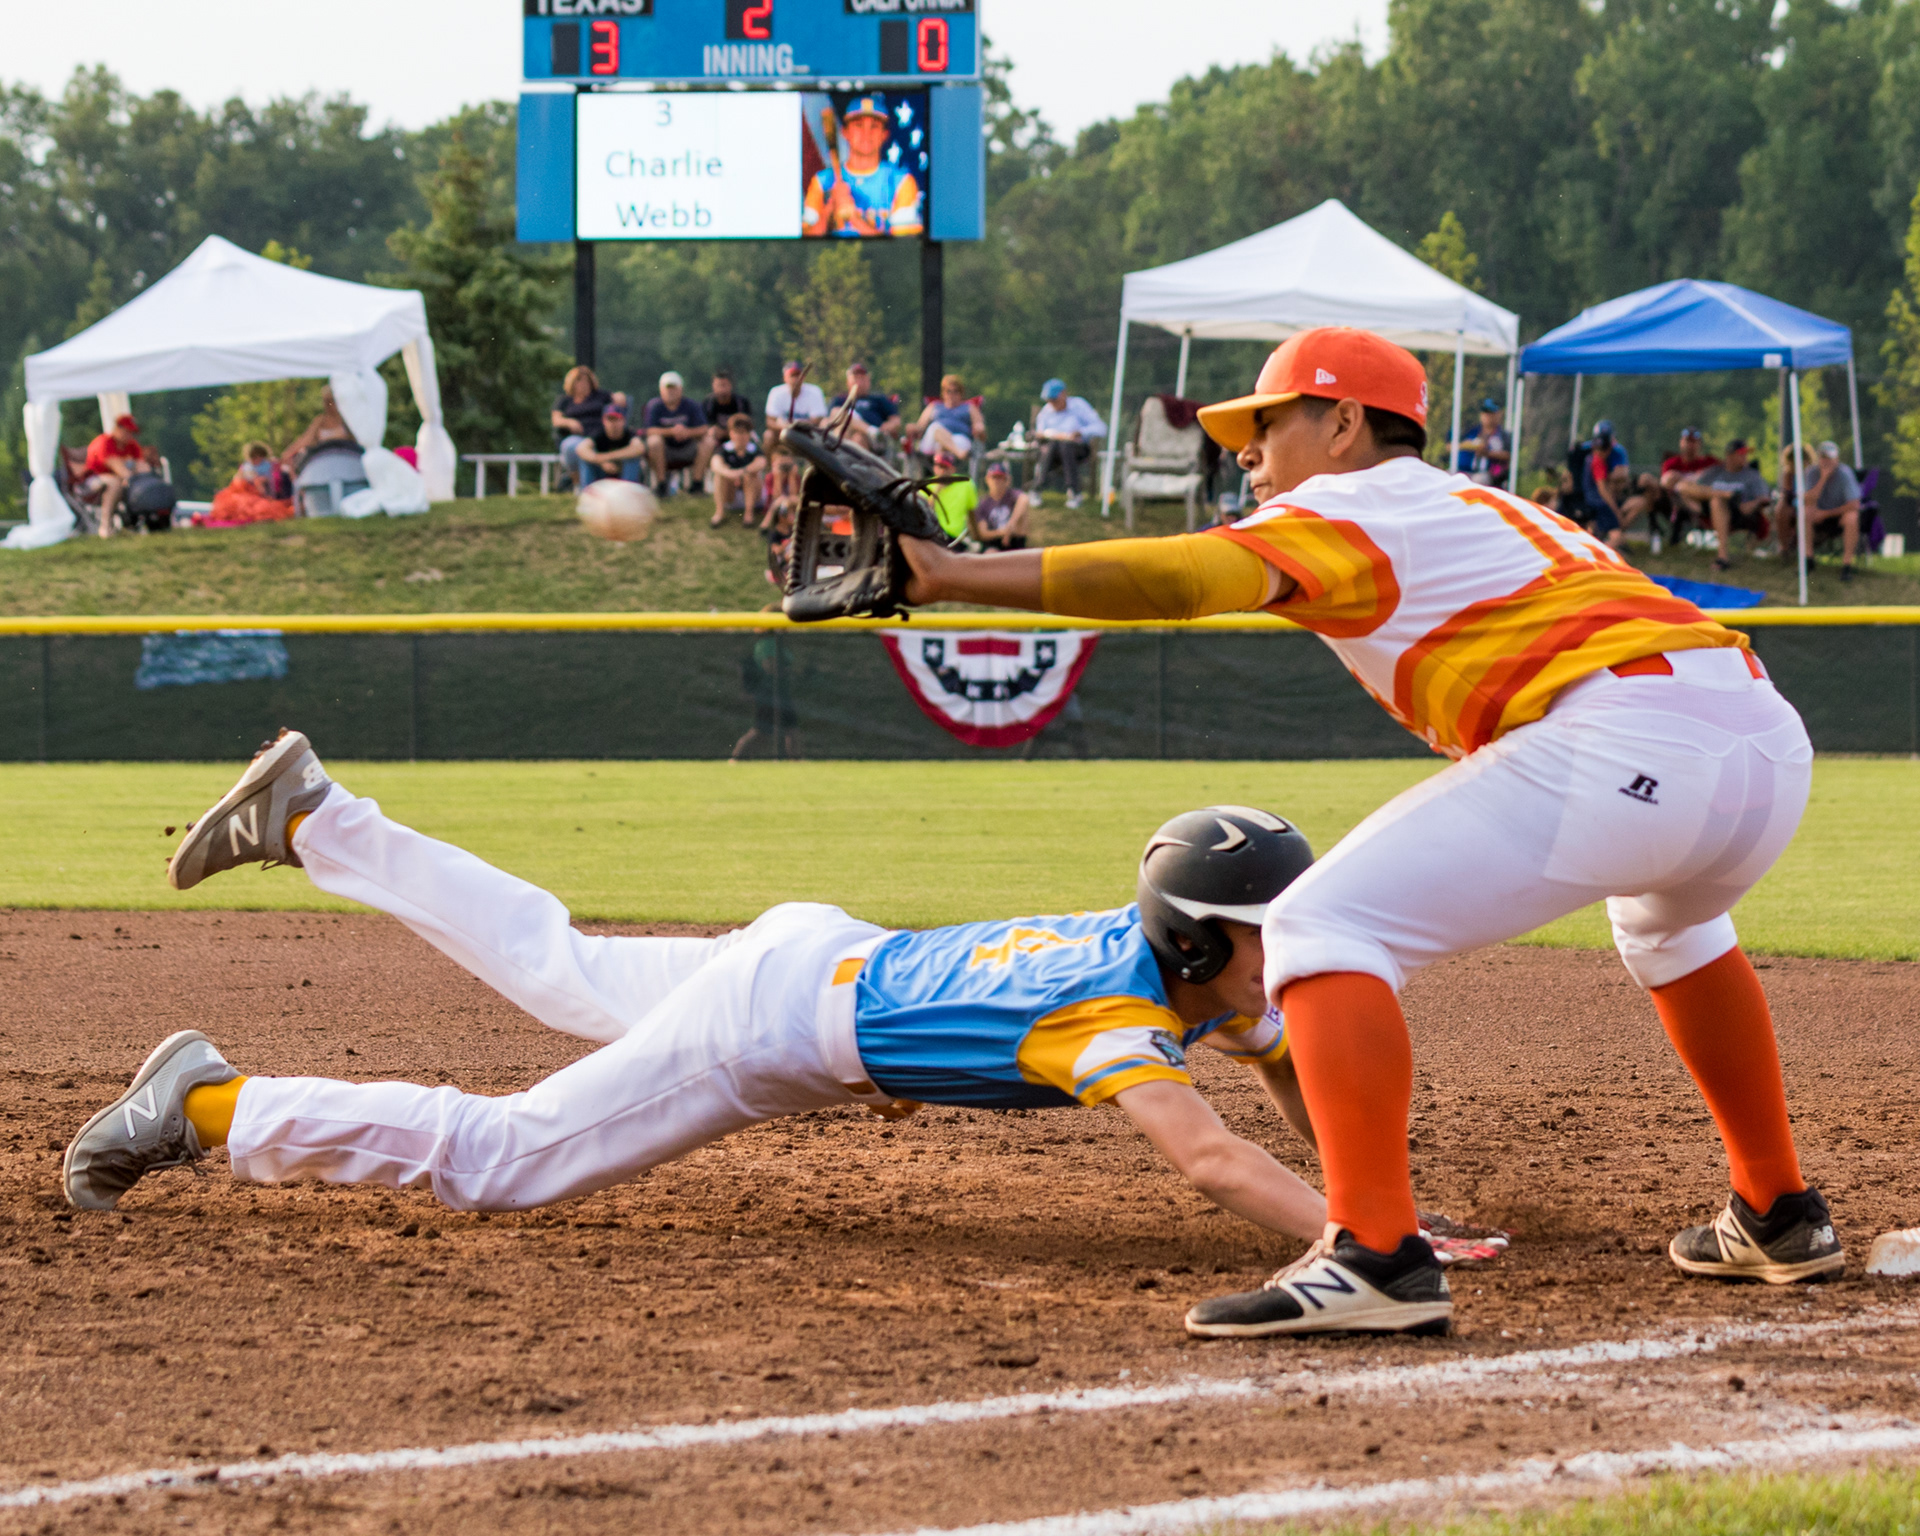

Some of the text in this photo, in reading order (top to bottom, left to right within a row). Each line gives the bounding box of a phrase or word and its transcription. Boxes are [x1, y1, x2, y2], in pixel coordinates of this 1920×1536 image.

[742, 0, 773, 38] 2
[591, 21, 620, 74] 3
[702, 43, 794, 75] INNING
[917, 18, 949, 72] 0
[655, 99, 673, 127] 3
[605, 149, 723, 178] Charlie
[616, 200, 712, 228] Webb
[228, 803, 260, 857] N
[123, 1083, 159, 1141] N
[1290, 1266, 1357, 1311] N
